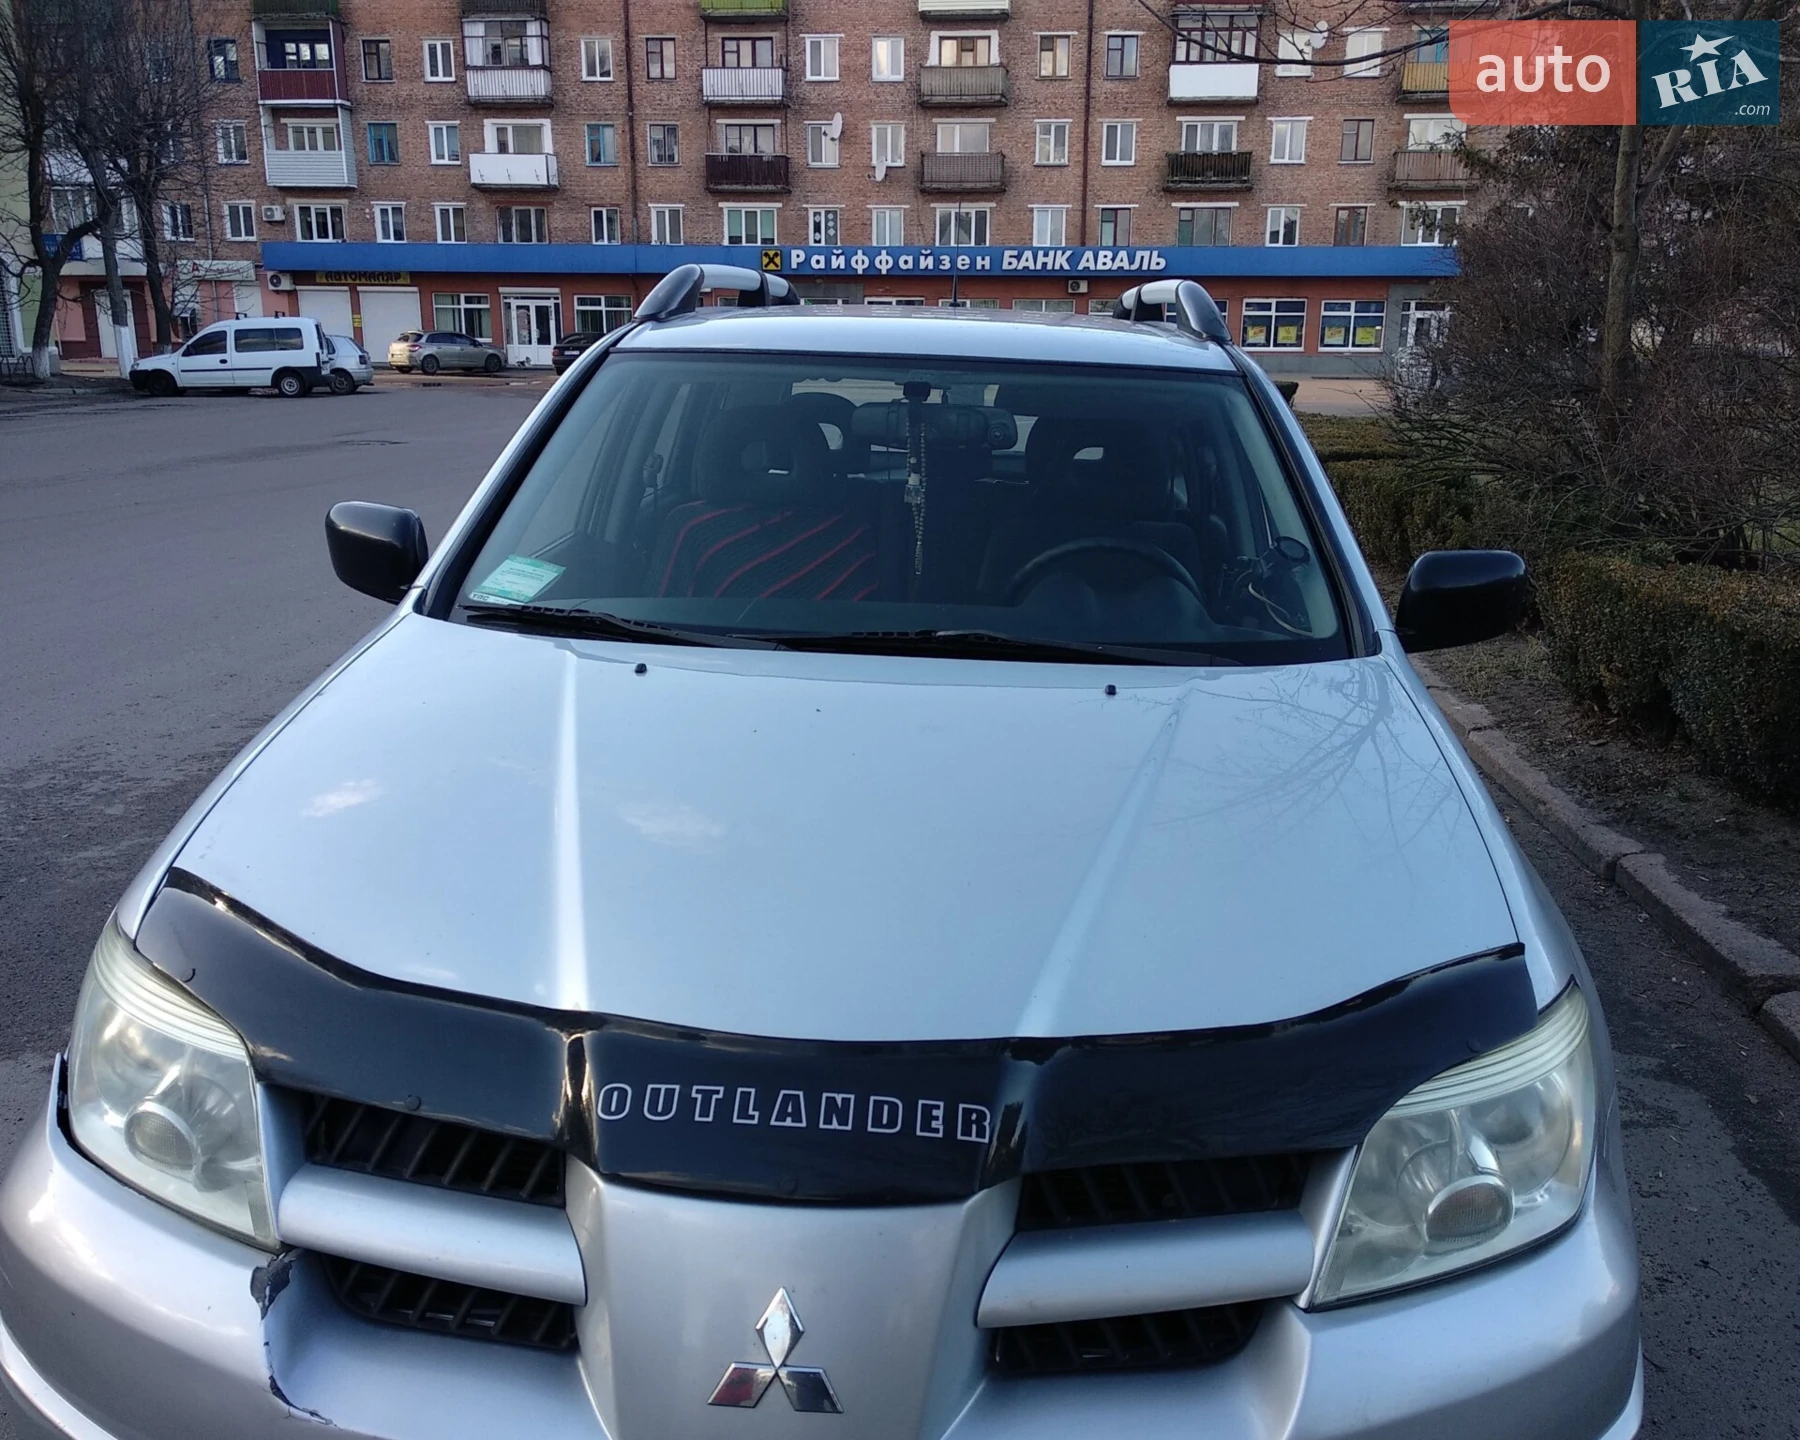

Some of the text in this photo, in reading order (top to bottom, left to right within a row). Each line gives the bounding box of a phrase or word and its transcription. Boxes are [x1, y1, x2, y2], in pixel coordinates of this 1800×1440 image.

[790, 249, 1167, 275] Райффайзен БАНК АВАЛЬ
[597, 1082, 991, 1144] OUTLANDER
